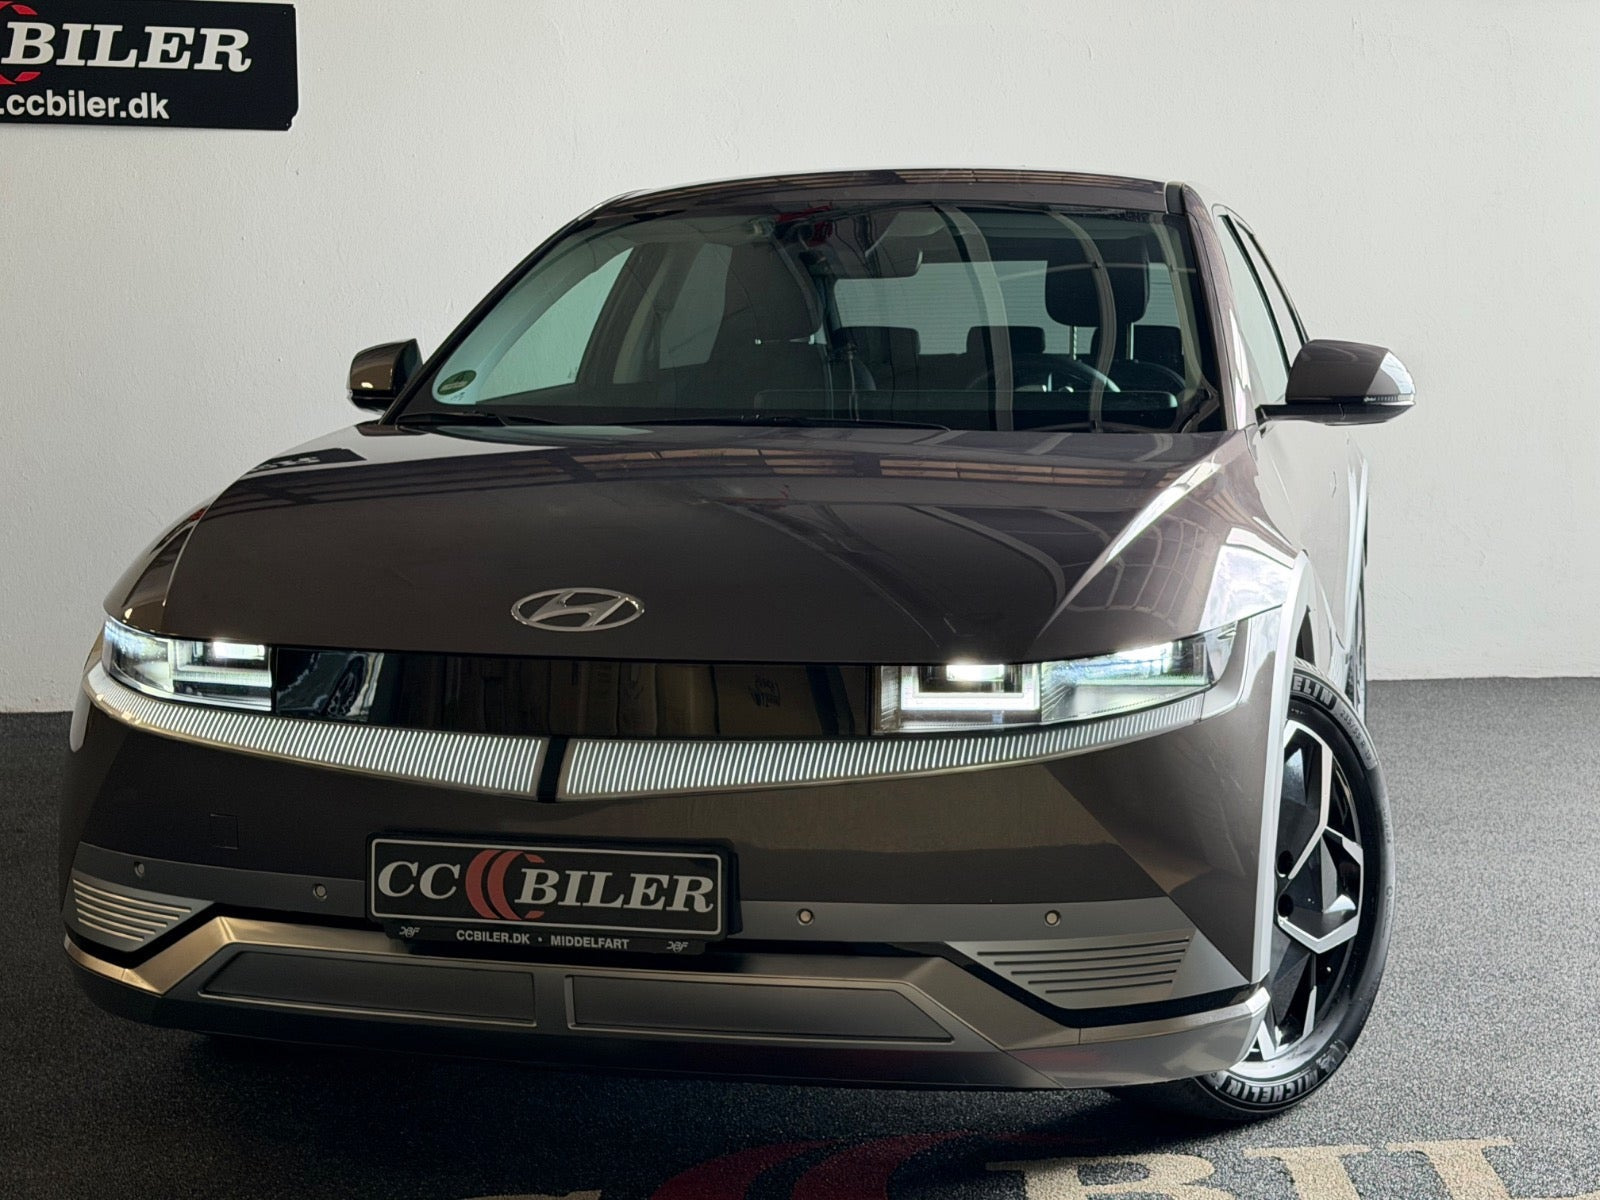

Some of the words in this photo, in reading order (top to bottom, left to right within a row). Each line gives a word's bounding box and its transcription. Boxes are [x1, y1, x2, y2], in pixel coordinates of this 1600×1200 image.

[1, 22, 252, 72] BILER
[378, 861, 460, 899] CC
[514, 867, 714, 913] BILER
[456, 929, 531, 945] CCBILER.DK
[550, 935, 630, 950] MIDDELFART
[1226, 1069, 1319, 1103] MICHELIN
